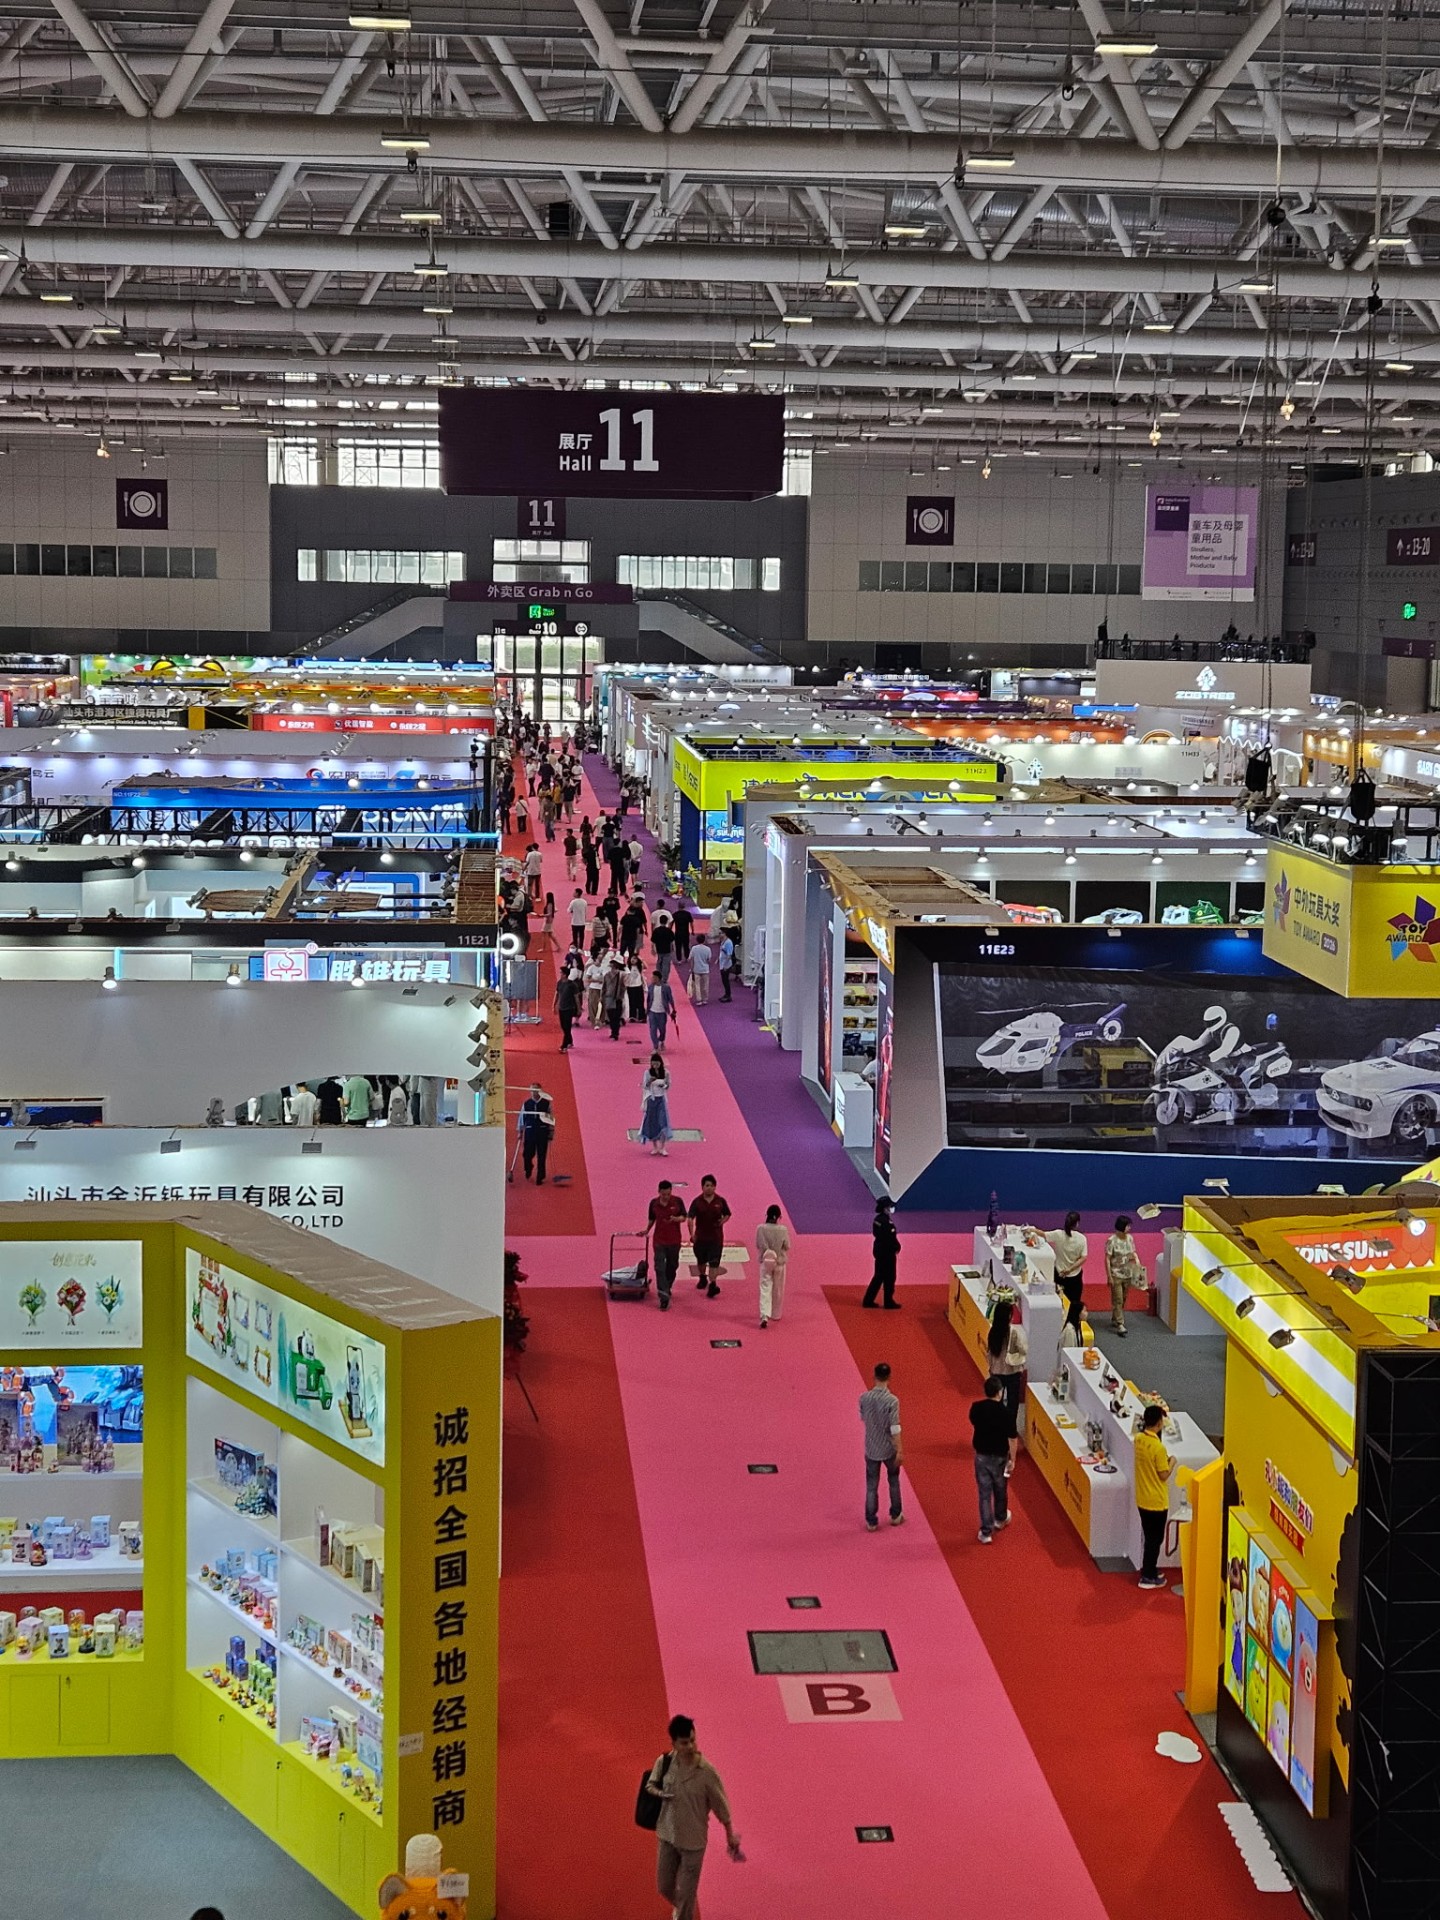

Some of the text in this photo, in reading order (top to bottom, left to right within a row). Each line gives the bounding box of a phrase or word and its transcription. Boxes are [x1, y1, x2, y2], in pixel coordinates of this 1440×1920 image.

[559, 433, 593, 450] 展厅
[599, 408, 659, 471] 11
[559, 455, 592, 471] Hall
[529, 500, 555, 526] 11
[1412, 537, 1430, 555] 13-20
[487, 585, 525, 597] 外卖区
[529, 586, 593, 598] Grab n Go
[542, 622, 557, 635] 10
[1294, 886, 1341, 928] 中外玩具大奖
[1294, 920, 1302, 937] TOY
[1302, 924, 1321, 946] AWARD
[1400, 923, 1427, 933] TOY
[457, 936, 490, 945] 11E21
[1385, 934, 1423, 943] AWARD
[979, 944, 1015, 955] 11E23
[1270, 1063, 1289, 1075] POLICE
[432, 1406, 469, 1832] 诚招全国各地经销商
[806, 1683, 871, 1715] B
